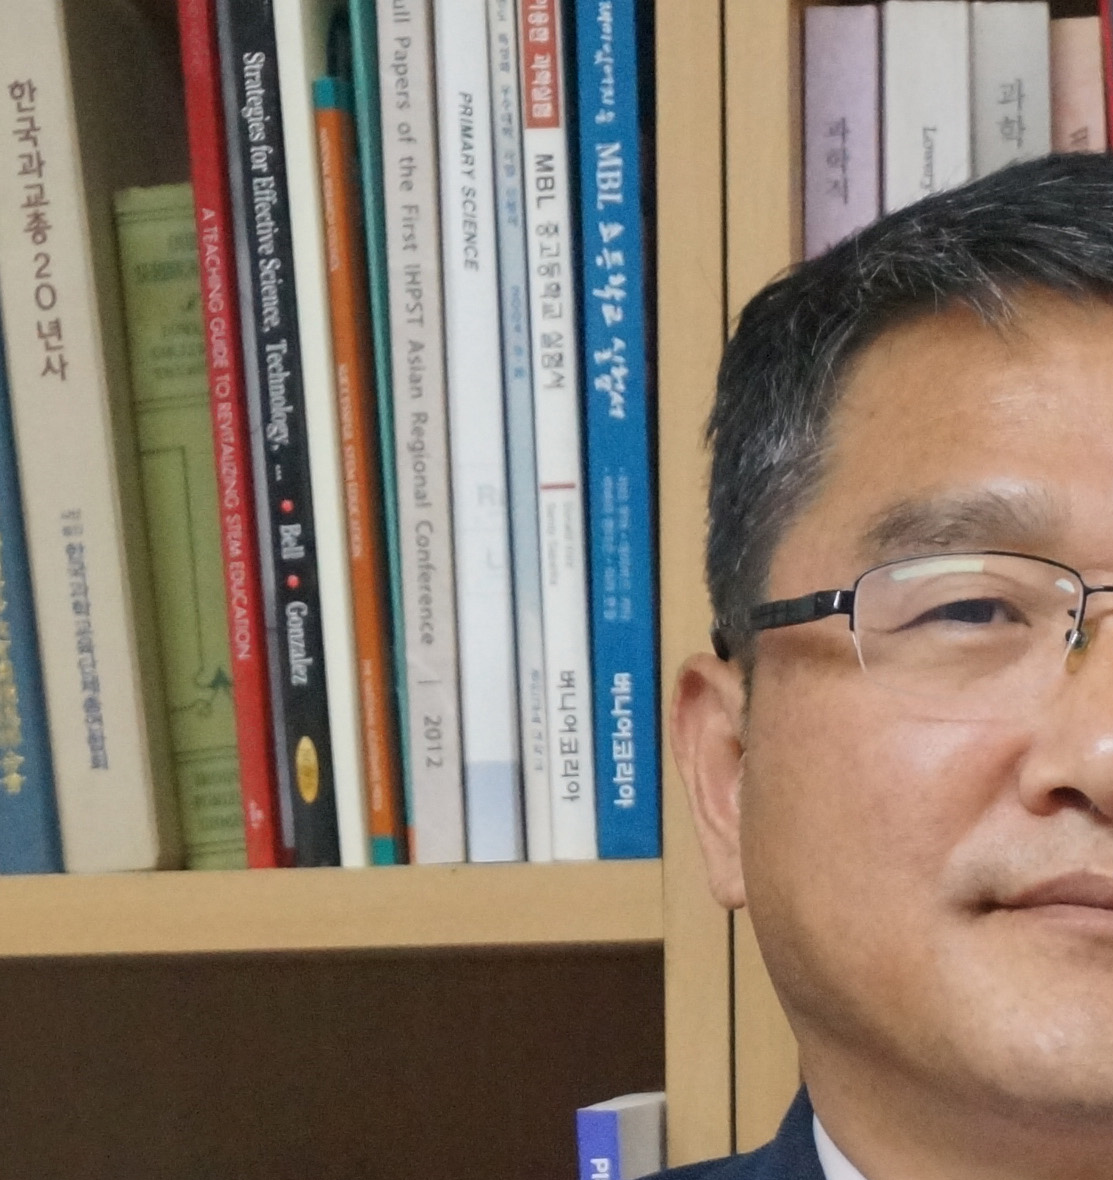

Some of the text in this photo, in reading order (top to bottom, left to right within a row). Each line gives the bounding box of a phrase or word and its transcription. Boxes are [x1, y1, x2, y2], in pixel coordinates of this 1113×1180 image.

[391, 37, 412, 109] Papers
[397, 122, 417, 143] of
[921, 126, 938, 192] Lowery
[399, 157, 417, 191] the
[460, 91, 480, 272] PRIMARY SCIENCE
[595, 142, 623, 209] MBL
[401, 205, 421, 251] First
[404, 264, 425, 326] IHPST
[534, 154, 565, 390] MBL 중고등학교 실험서
[240, 52, 312, 686] Strategies for Effective Science, Technology, Bell Gonzalez
[408, 340, 427, 399] Asian
[202, 207, 252, 660] A TEACHING GUIDE TO REVITALIZING STEM EDUCATION
[406, 412, 432, 508] Regional
[415, 520, 436, 645] Conference
[424, 715, 443, 768] 2012
[556, 669, 581, 803] 버니어코리아
[610, 671, 636, 809] 버니어코리아
